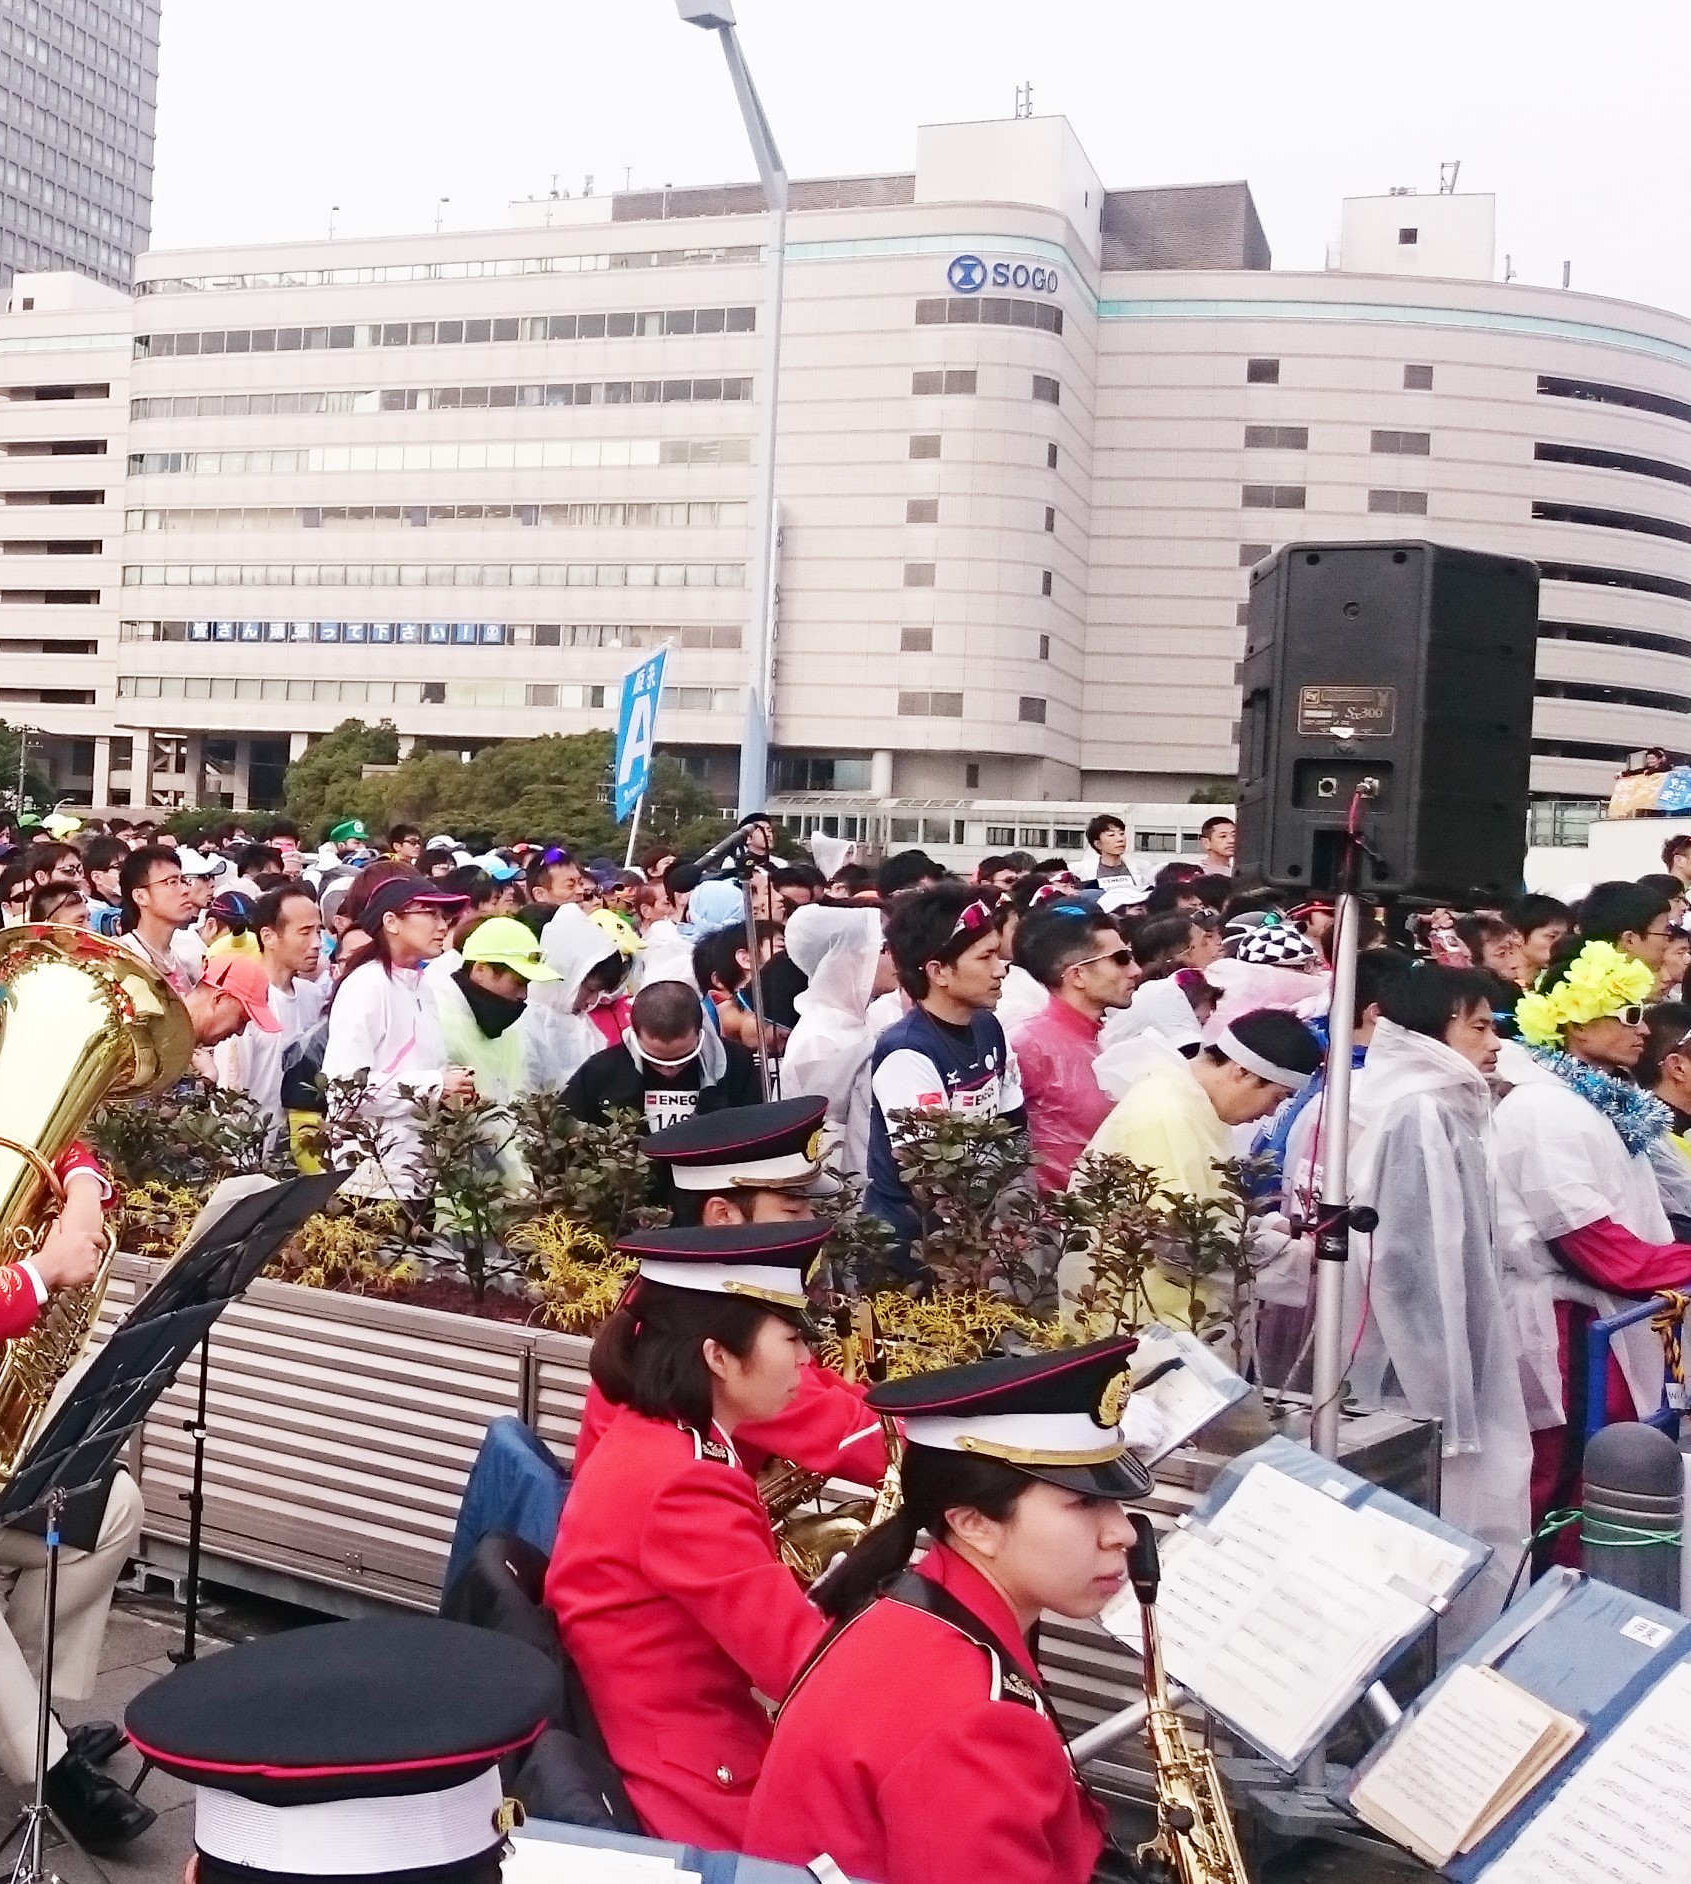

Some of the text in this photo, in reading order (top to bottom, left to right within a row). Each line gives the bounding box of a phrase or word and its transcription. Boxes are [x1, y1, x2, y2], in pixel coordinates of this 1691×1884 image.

[992, 262, 1058, 293] SOGO
[618, 693, 652, 786] A
[659, 1095, 698, 1106] ENEO
